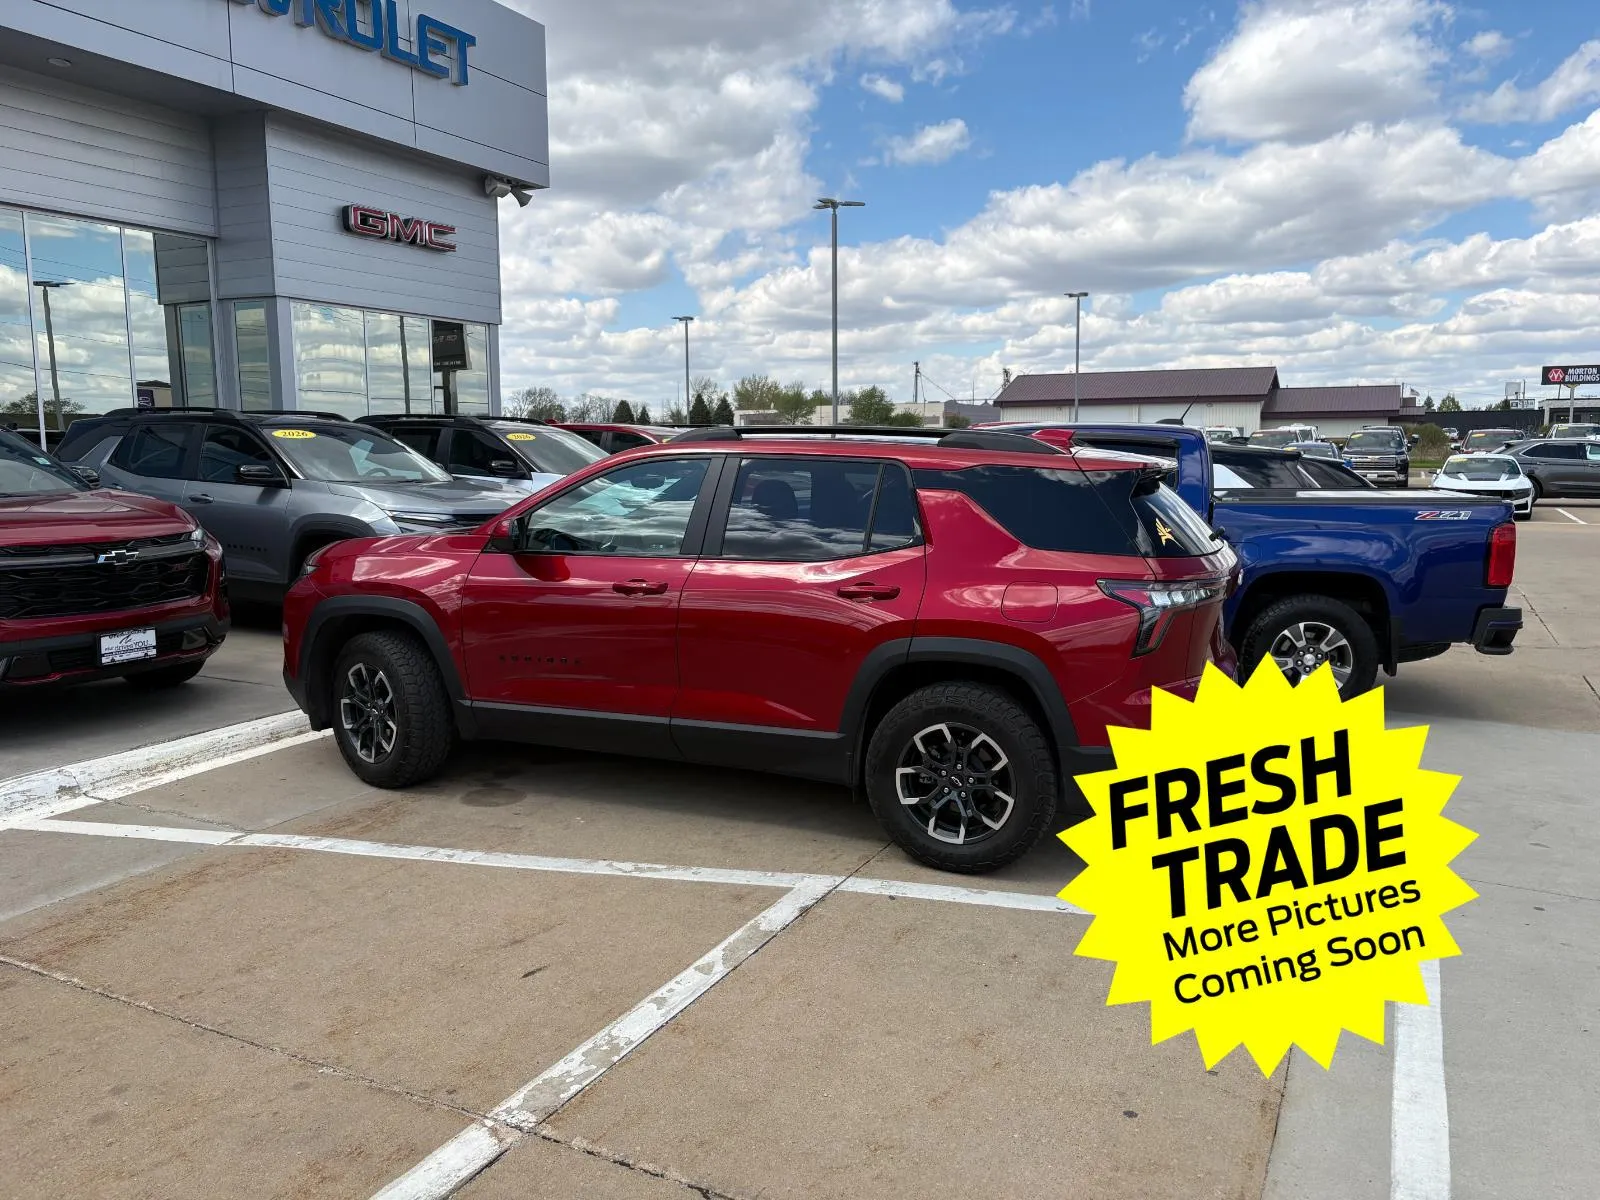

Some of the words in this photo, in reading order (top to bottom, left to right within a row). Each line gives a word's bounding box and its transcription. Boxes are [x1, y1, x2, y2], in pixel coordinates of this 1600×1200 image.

[343, 204, 457, 252] GMC
[1568, 367, 1598, 375] MORTON
[1565, 374, 1600, 382] BUILDINGS
[1414, 510, 1473, 520] Z71
